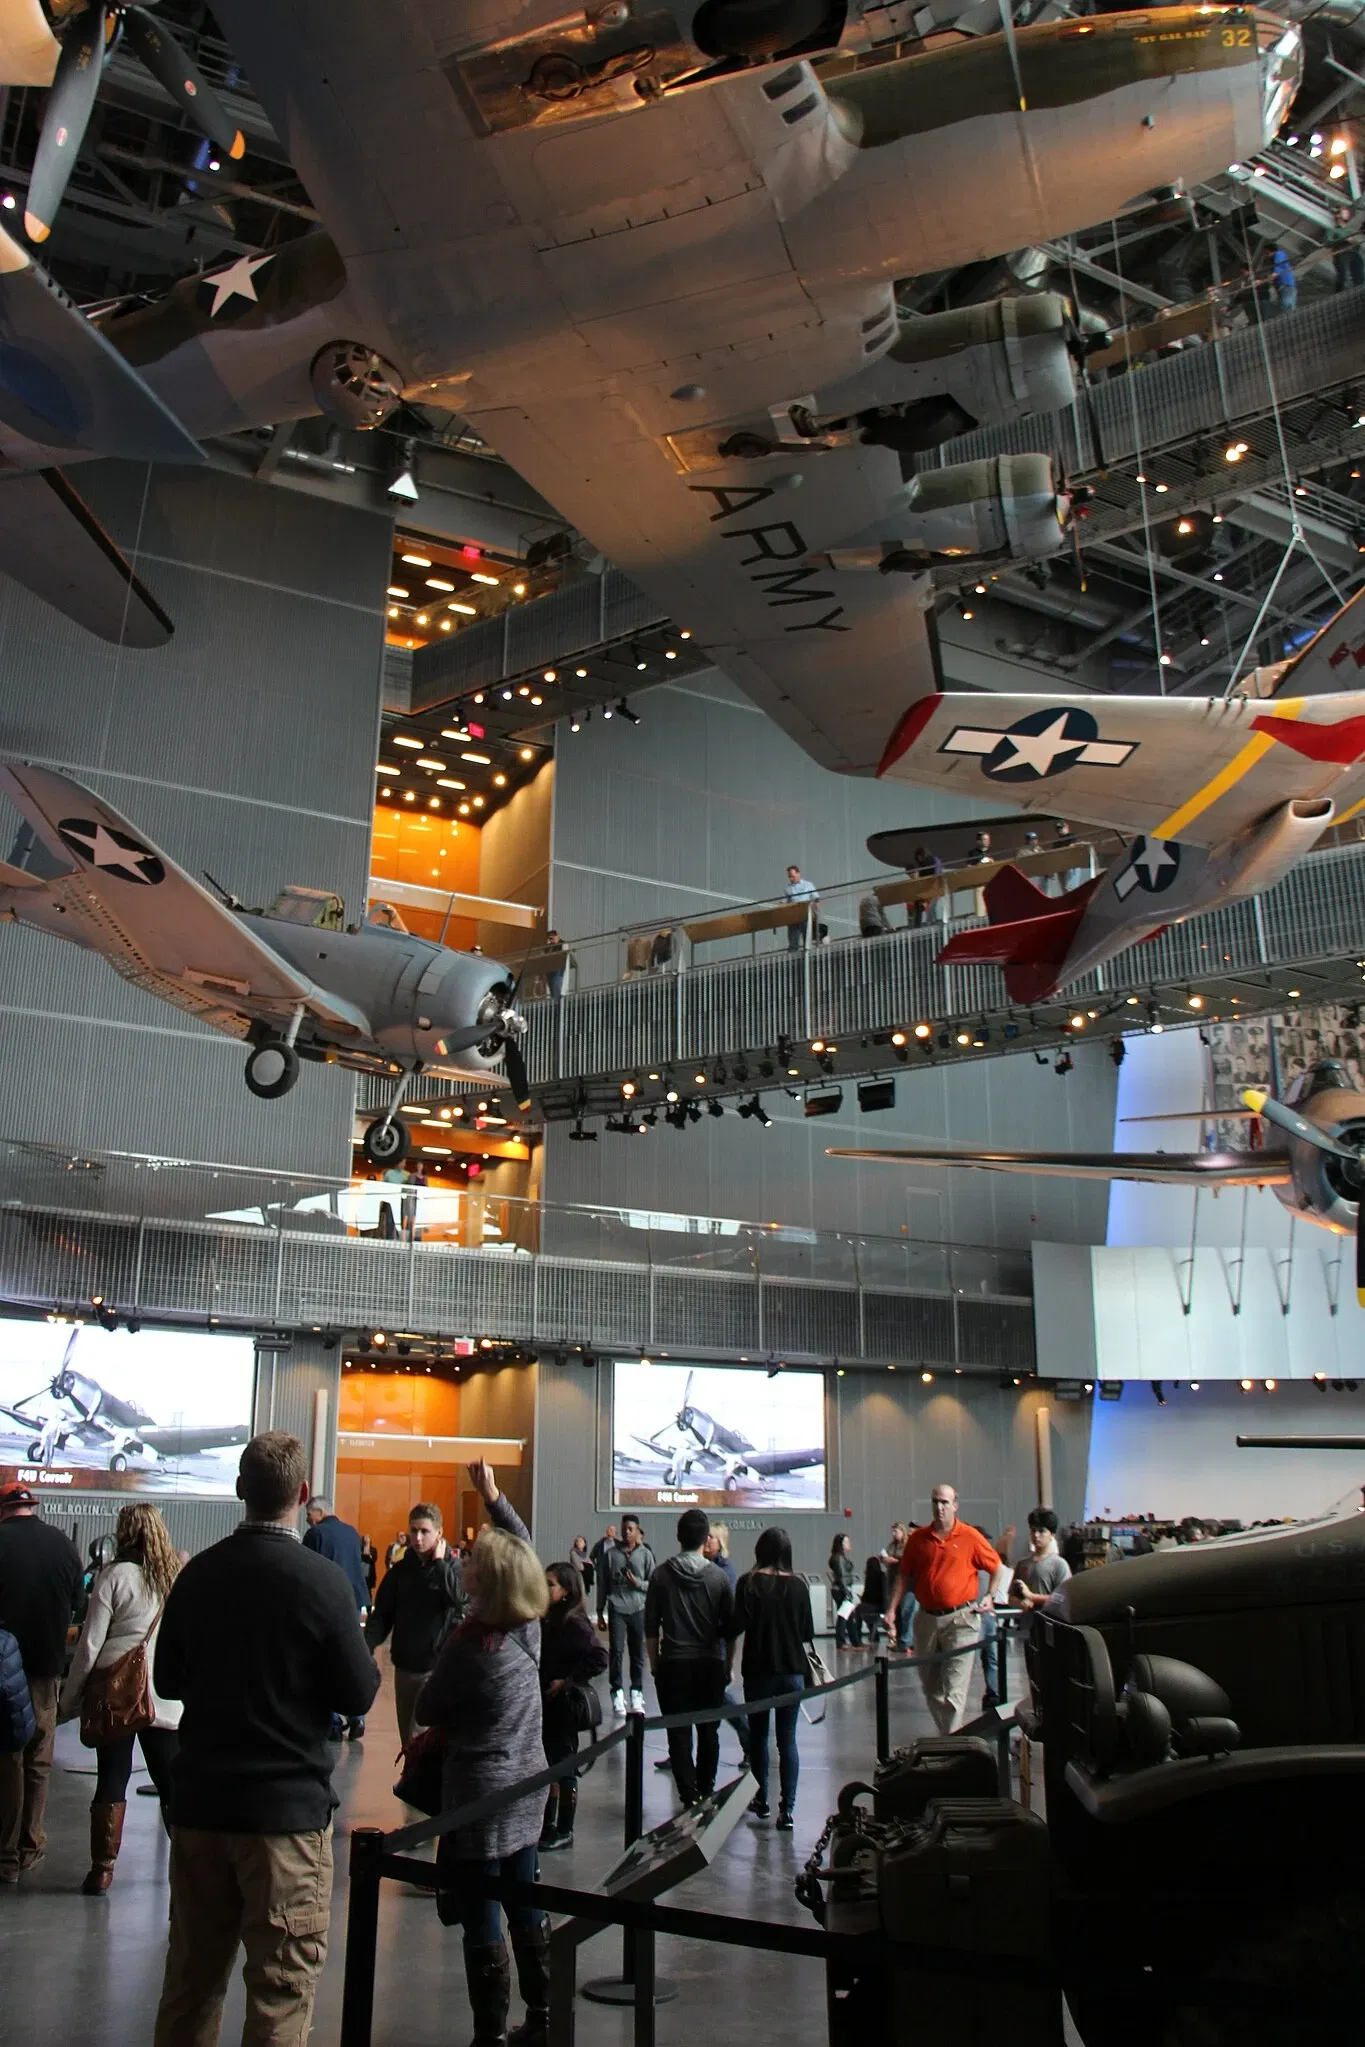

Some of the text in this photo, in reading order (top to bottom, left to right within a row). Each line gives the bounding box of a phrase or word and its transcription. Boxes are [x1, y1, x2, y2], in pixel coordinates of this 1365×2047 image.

[1159, 32, 1183, 41] GAL
[1221, 29, 1251, 47] 32
[688, 485, 852, 632] ARMY
[17, 1469, 74, 1484] F4U Corsair
[43, 1503, 63, 1515] THE
[67, 1503, 108, 1516] BOEING
